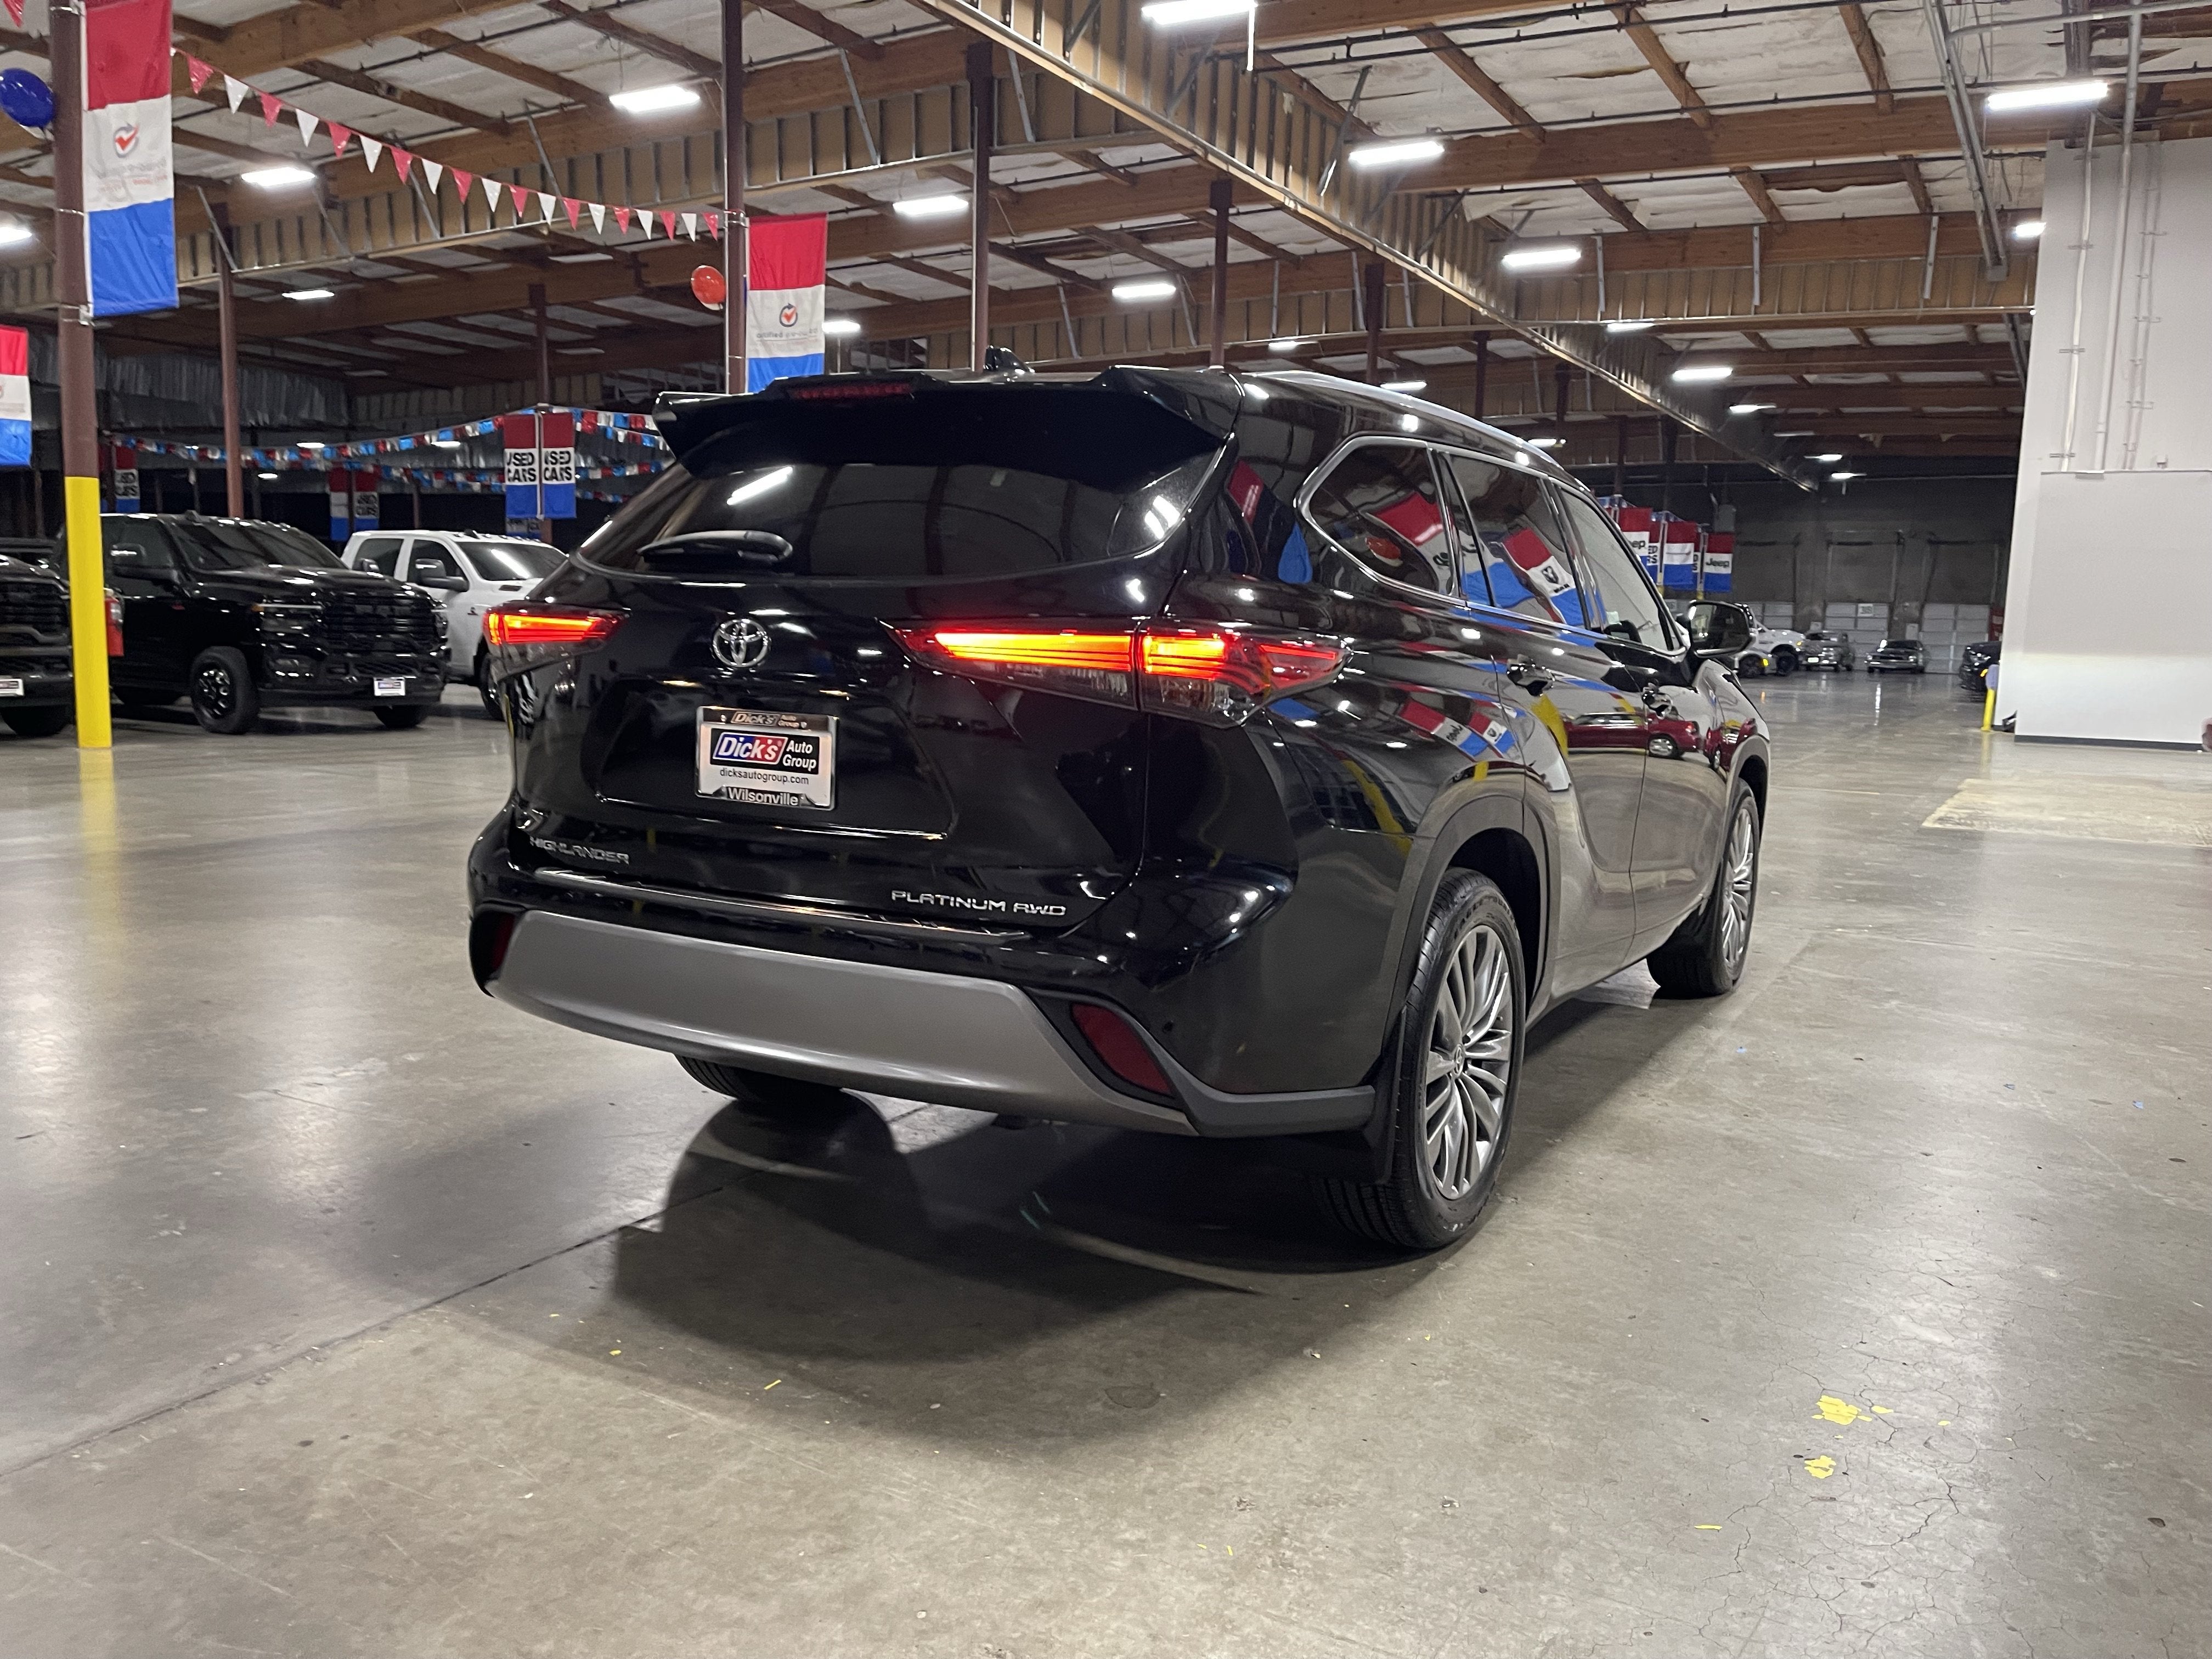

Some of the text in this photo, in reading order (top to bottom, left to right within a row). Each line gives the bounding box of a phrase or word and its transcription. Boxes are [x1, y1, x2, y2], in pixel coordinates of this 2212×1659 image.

[1628, 540, 1645, 549] eep
[1706, 558, 1729, 567] Jeep
[718, 737, 778, 761] Dick's
[787, 740, 813, 754] Auto
[782, 754, 816, 771] Group
[720, 768, 809, 785] dicksautogroup.com
[727, 787, 799, 806] Wilsonville
[891, 890, 1066, 916] PLATINUM AWD
